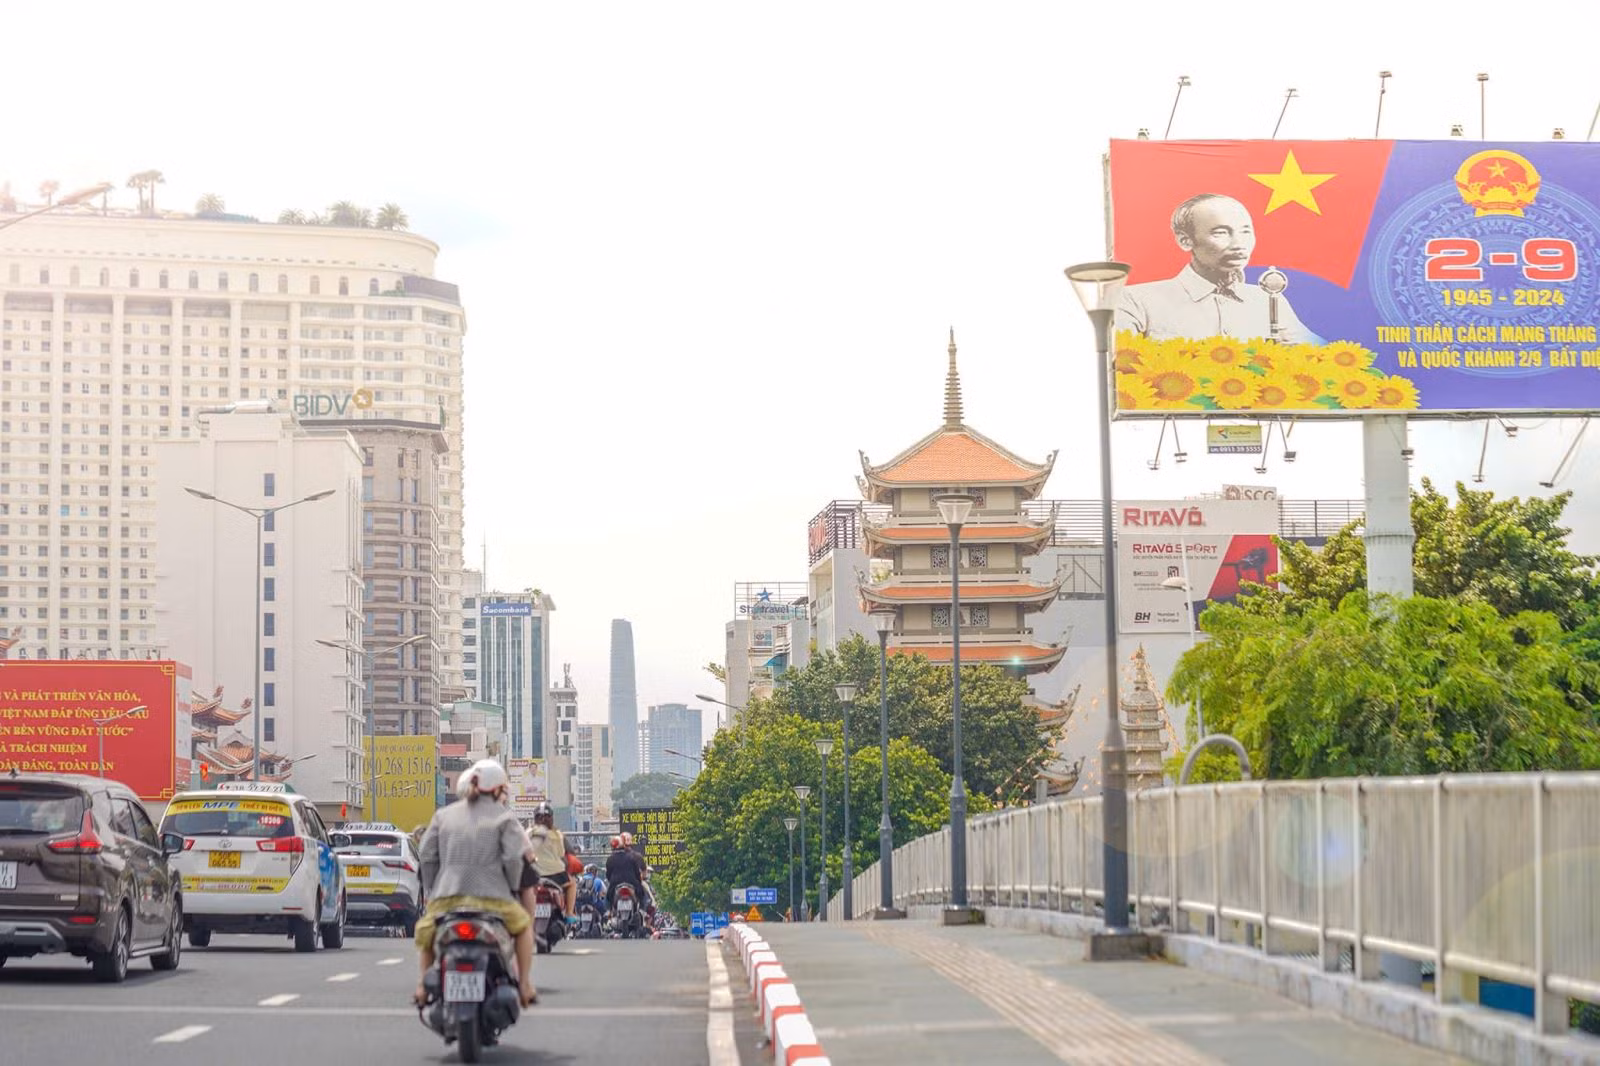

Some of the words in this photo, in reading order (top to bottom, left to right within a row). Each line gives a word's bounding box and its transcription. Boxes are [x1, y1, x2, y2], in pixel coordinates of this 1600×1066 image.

[1441, 289, 1493, 306] 1945
[1513, 289, 1565, 306] 2024
[1376, 326, 1411, 343] TINH
[1457, 323, 1496, 343] CÁCH
[1501, 326, 1546, 346] MẠNG
[1548, 322, 1597, 343] THÁNG
[1397, 347, 1418, 368] VÀ
[1421, 345, 1461, 369] QUỐC
[1464, 347, 1515, 367] KHÁNH
[1518, 351, 1543, 367] 2/9
[1549, 345, 1577, 367] BẤT
[294, 394, 351, 416] BIDV
[482, 606, 530, 615] Sacombank
[1135, 612, 1151, 620] BH
[3, 689, 19, 701] VÀ
[22, 689, 51, 701] PHÁT
[88, 689, 112, 701] VĂN
[114, 689, 141, 703] HÓA,
[0, 708, 21, 719] IỆT
[23, 709, 49, 718] NAM
[51, 707, 73, 718] ĐÁP
[37, 724, 69, 736] VỮNG
[9, 741, 48, 753] TRÁCH
[50, 743, 87, 755] NHIỆM
[58, 759, 88, 771] TOÀN
